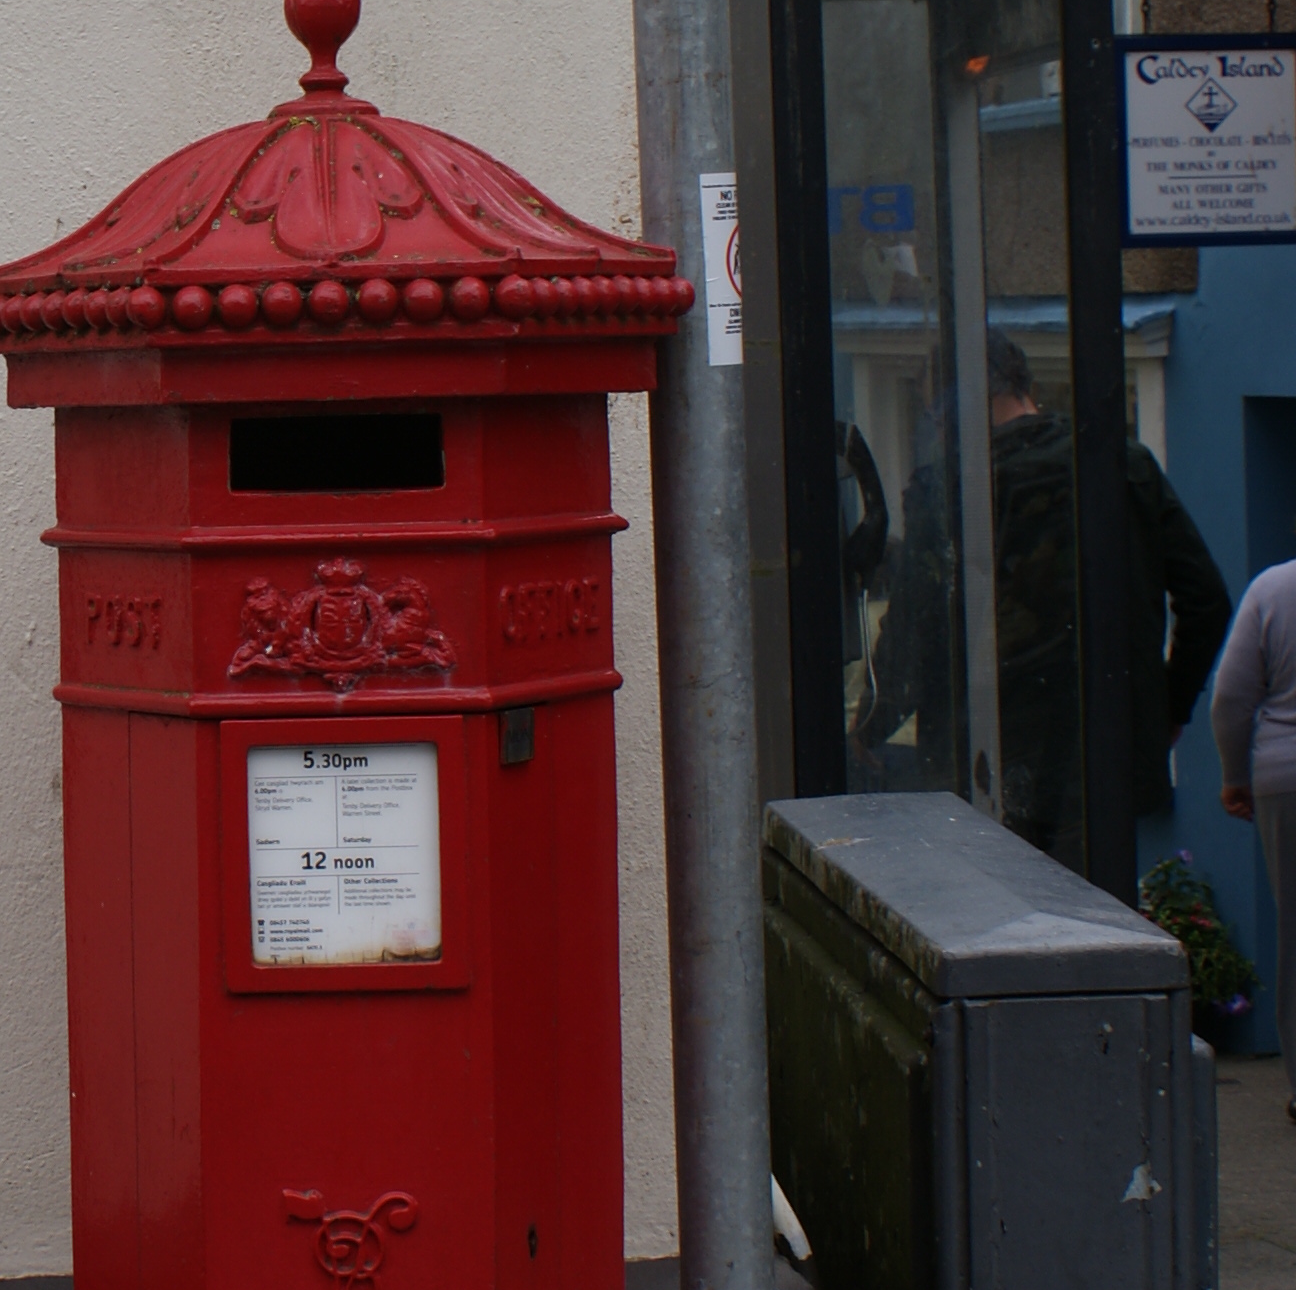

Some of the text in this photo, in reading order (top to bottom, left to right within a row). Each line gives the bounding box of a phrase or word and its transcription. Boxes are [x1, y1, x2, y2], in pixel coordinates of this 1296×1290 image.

[1137, 55, 1285, 84] Caldey Island
[1189, 136, 1242, 146] CHOCOLATE
[1146, 160, 1277, 172] THE MONKS OF CALDEY
[1158, 183, 1267, 194] MANY OTHER GIFTS
[1172, 199, 1254, 209] ALL WELCOME
[88, 577, 601, 649] POST OFFICE
[303, 750, 369, 771] 5.30pm
[301, 852, 375, 870] 12 noon
